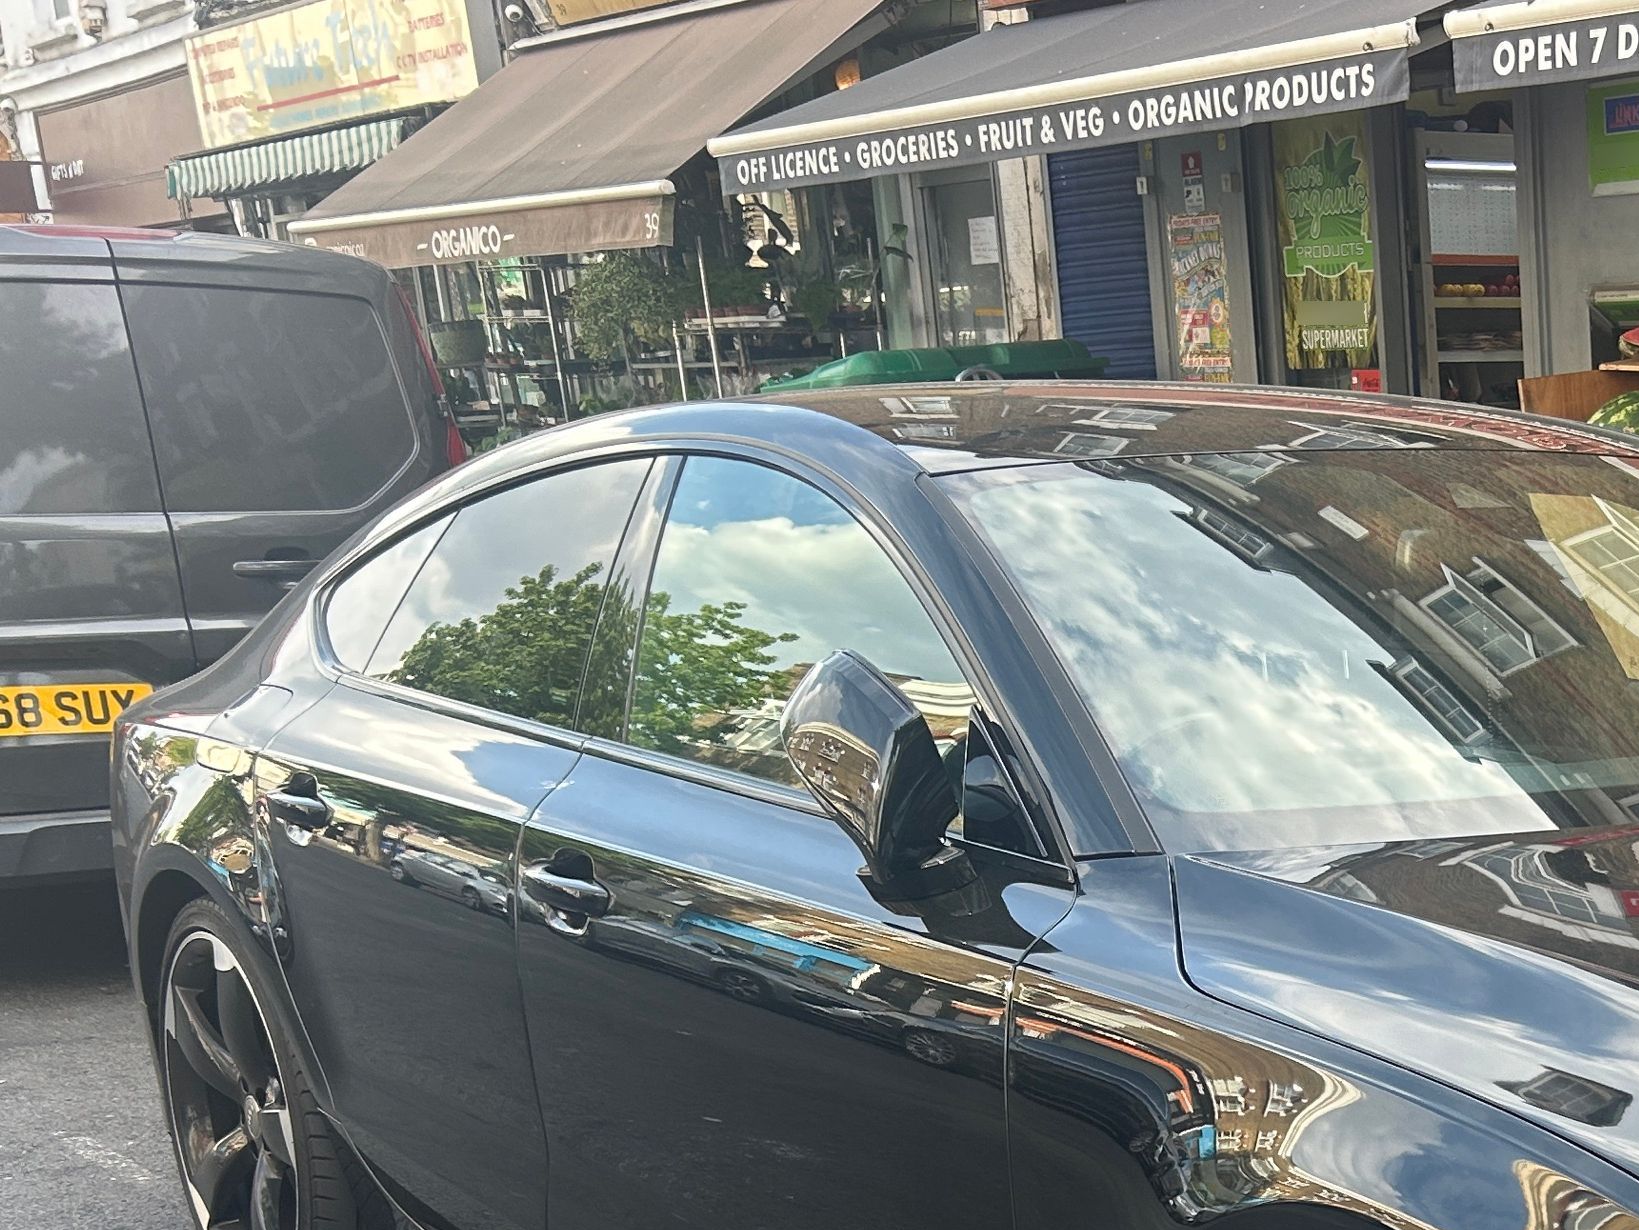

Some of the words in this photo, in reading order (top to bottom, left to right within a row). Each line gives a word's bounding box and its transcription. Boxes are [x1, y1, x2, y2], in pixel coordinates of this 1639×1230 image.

[407, 12, 445, 33] BATTERIES
[417, 41, 468, 65] INSTALLATION
[1492, 37, 1579, 76] OPEN
[1588, 28, 1607, 64] 7
[736, 157, 768, 185] OFF
[771, 146, 840, 181] LICENCE
[856, 129, 959, 170] GROCERIES
[977, 117, 1034, 152] FRUIT
[1040, 115, 1055, 144] &
[1059, 106, 1105, 140] VEG
[1128, 85, 1239, 131] ORGANIC
[1244, 63, 1376, 114] PRODUCTS
[1284, 165, 1323, 191] 100%
[643, 213, 660, 240] 39
[431, 225, 501, 260] ORGANICO
[1296, 242, 1365, 259] PRODUCTS
[1302, 328, 1369, 350] SUPERMARKET
[54, 689, 134, 726] SUY
